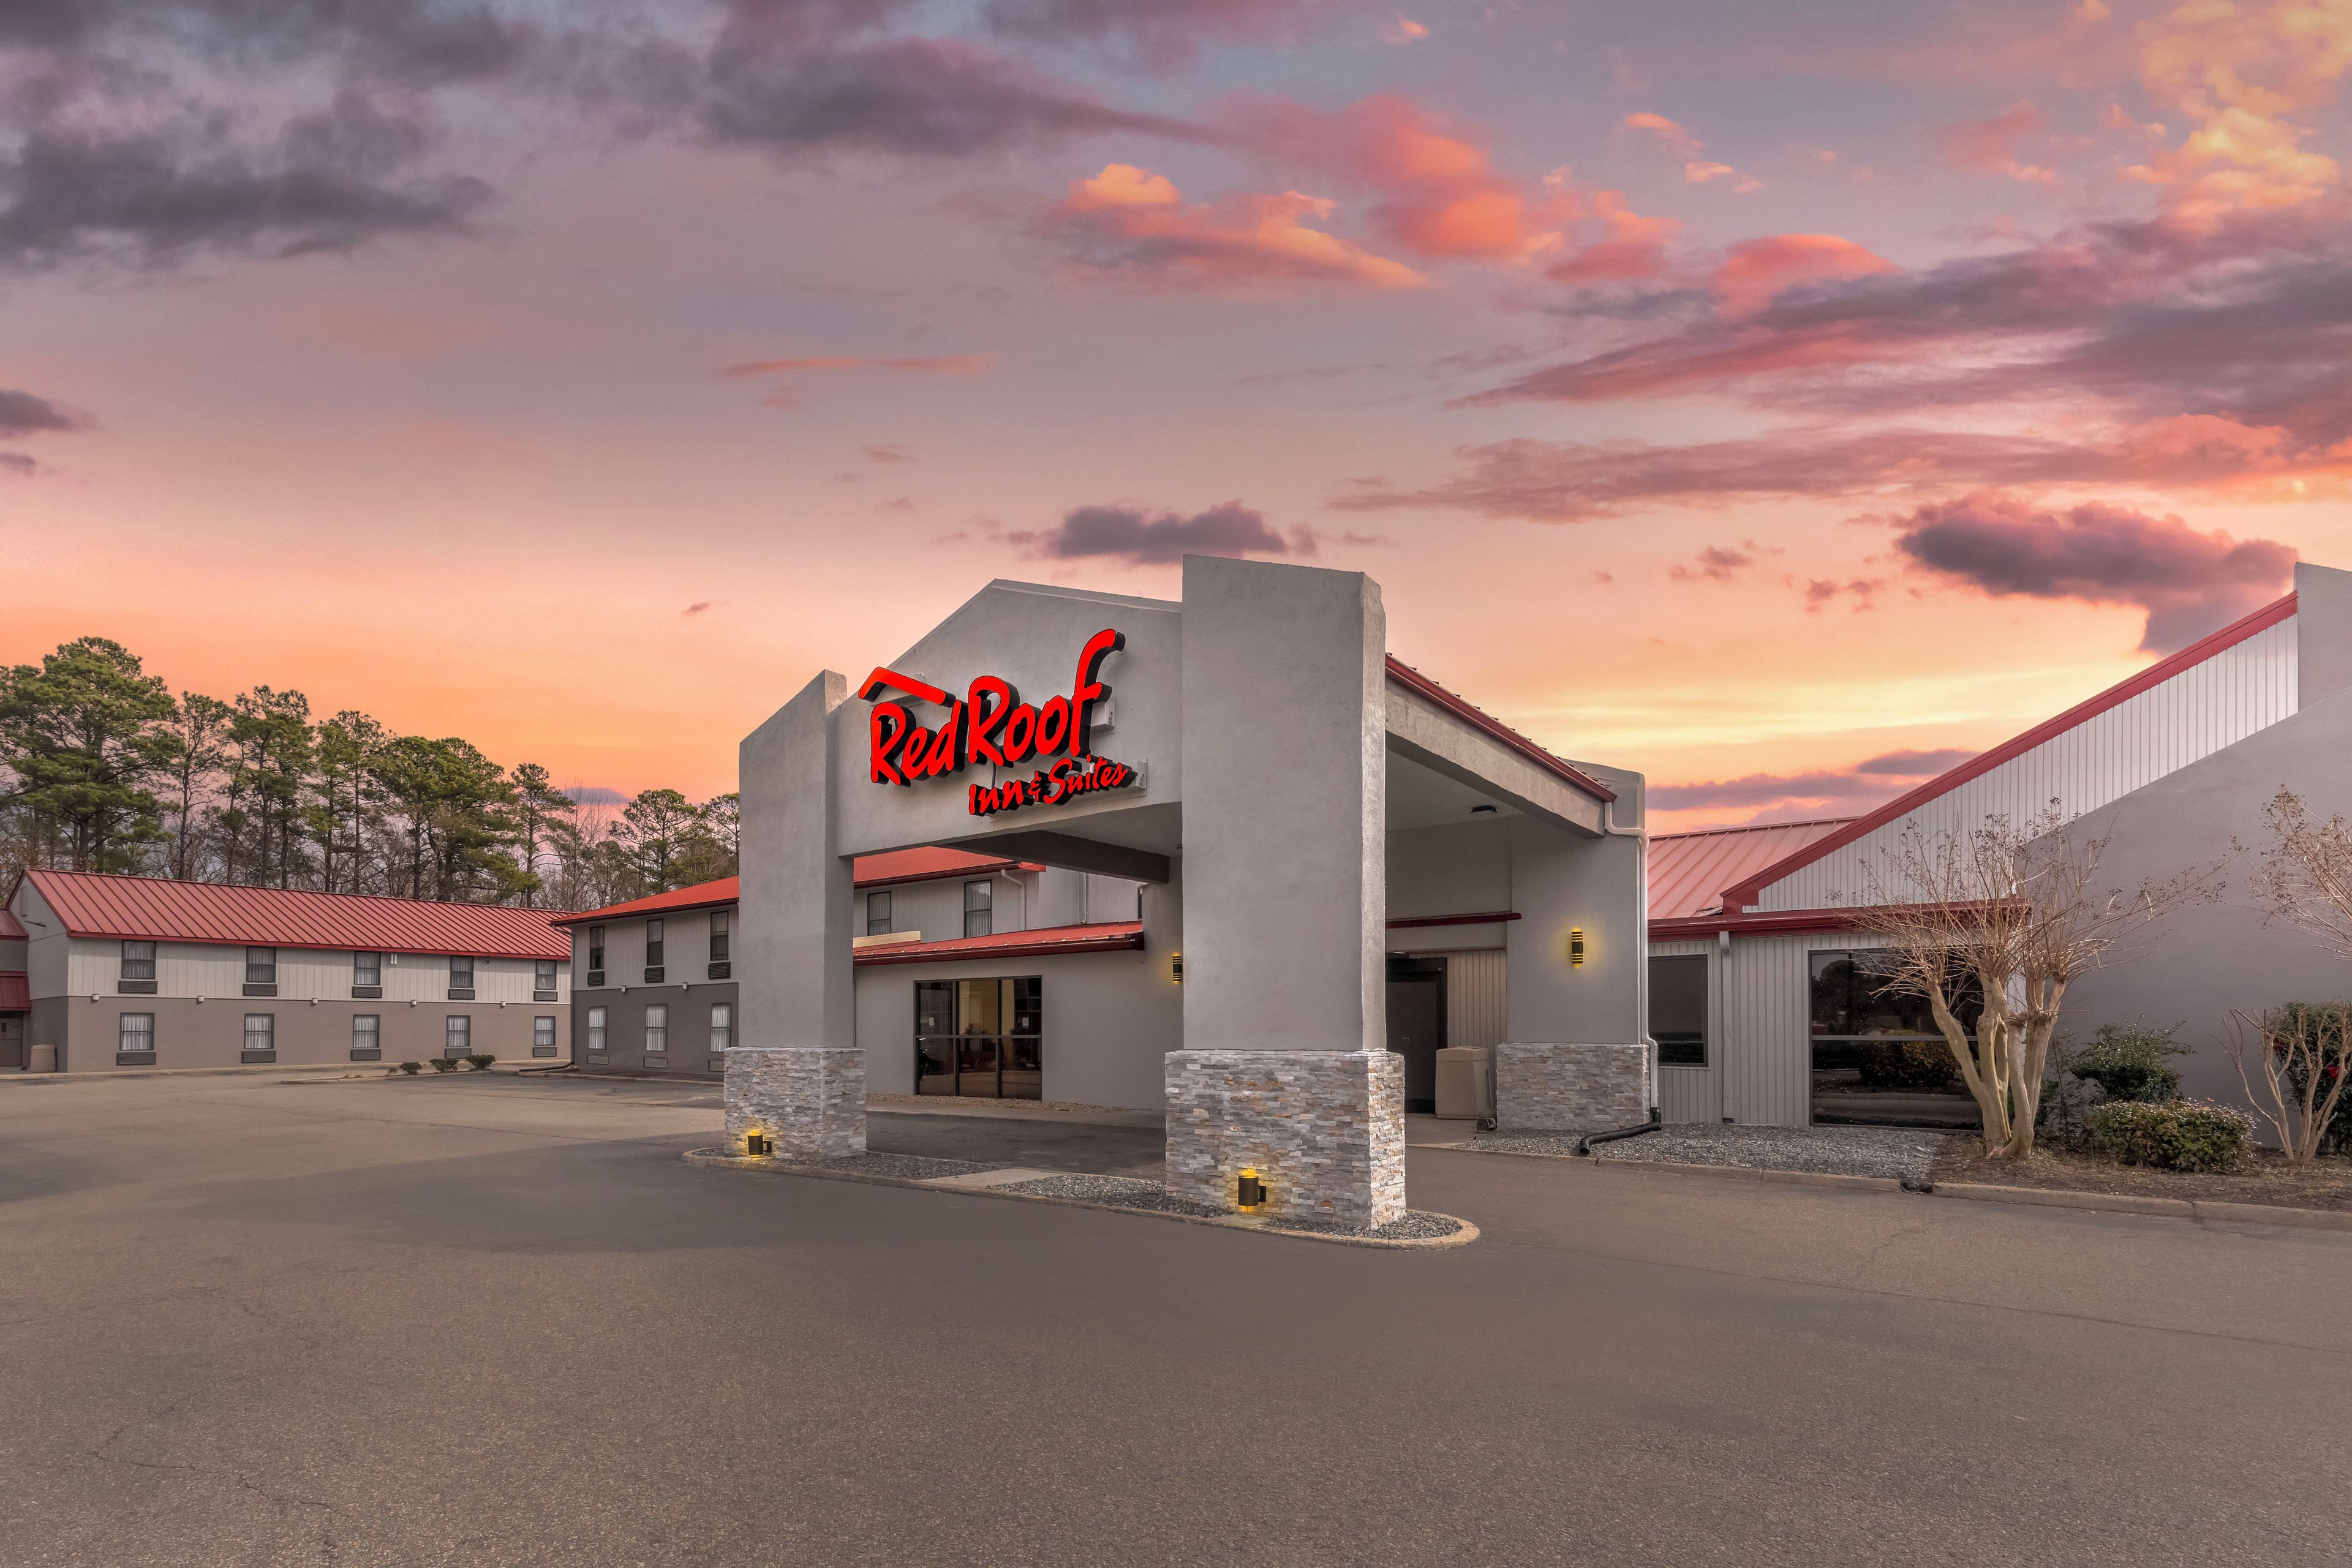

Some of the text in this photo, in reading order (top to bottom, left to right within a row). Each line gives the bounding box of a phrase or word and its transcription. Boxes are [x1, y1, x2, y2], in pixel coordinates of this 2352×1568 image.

[968, 779, 1025, 815] Inn
[1027, 771, 1042, 802] &
[1043, 754, 1128, 805] Suites
